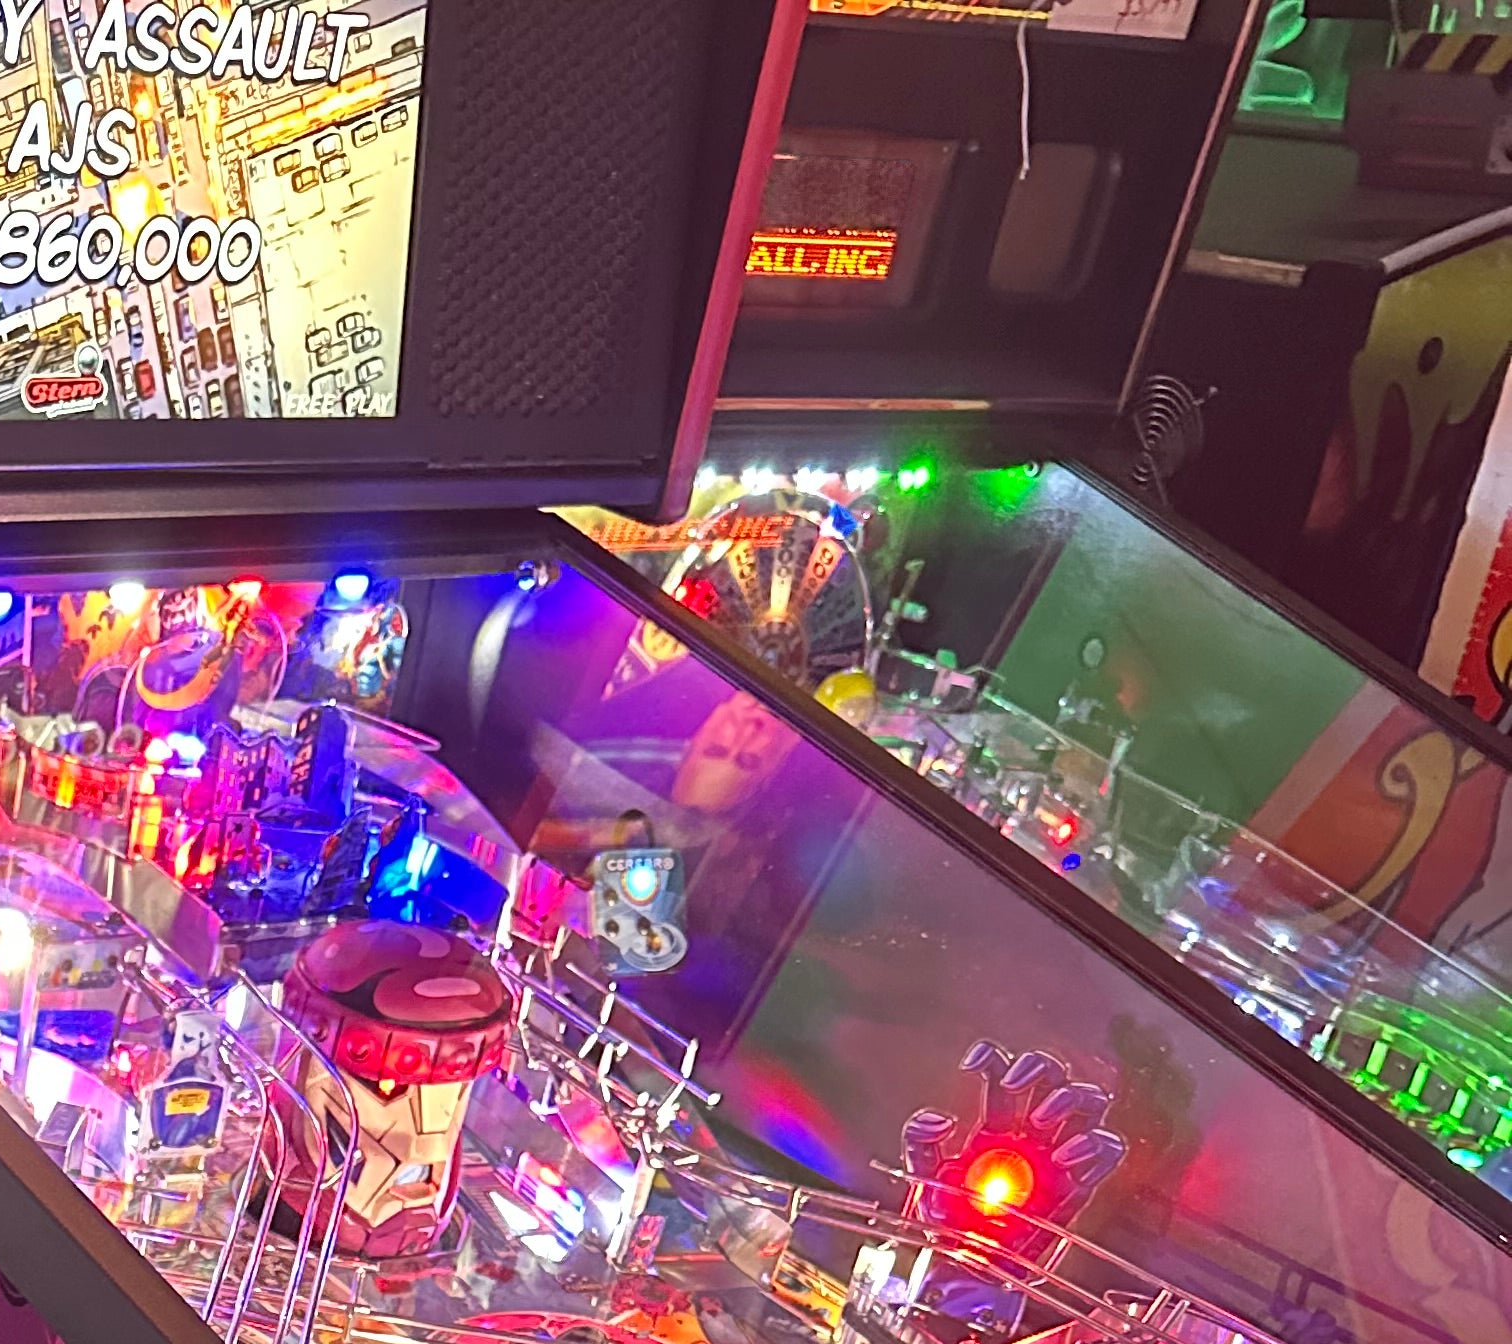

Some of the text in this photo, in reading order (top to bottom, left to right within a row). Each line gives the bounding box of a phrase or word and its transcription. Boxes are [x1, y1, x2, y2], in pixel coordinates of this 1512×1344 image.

[86, 2, 372, 85] ASSAULT
[8, 98, 137, 178] AJS
[29, 379, 102, 404] Stern
[284, 392, 394, 416] FREE PLAY
